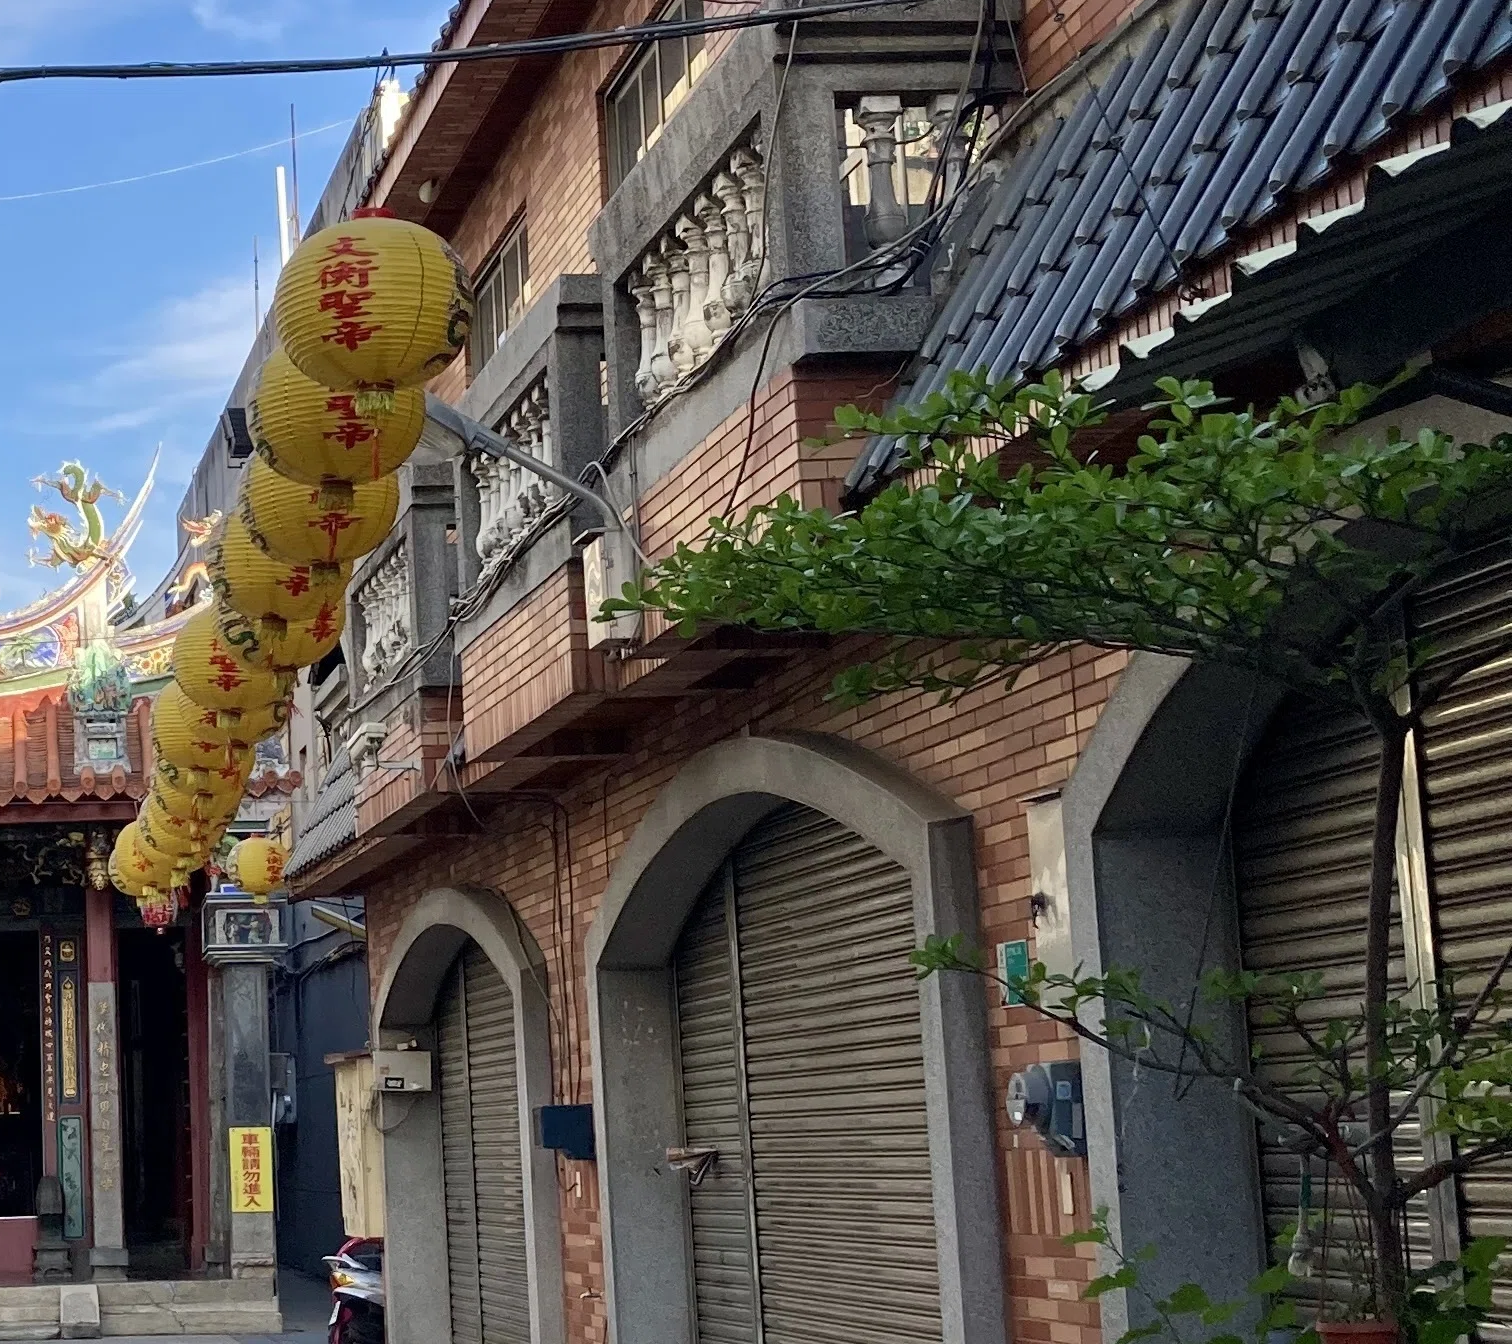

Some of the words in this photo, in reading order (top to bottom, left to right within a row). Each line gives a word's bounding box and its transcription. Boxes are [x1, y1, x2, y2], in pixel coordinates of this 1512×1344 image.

[314, 235, 383, 353] 文衡聖帝
[241, 1133, 262, 1208] 車輛請勿進入
